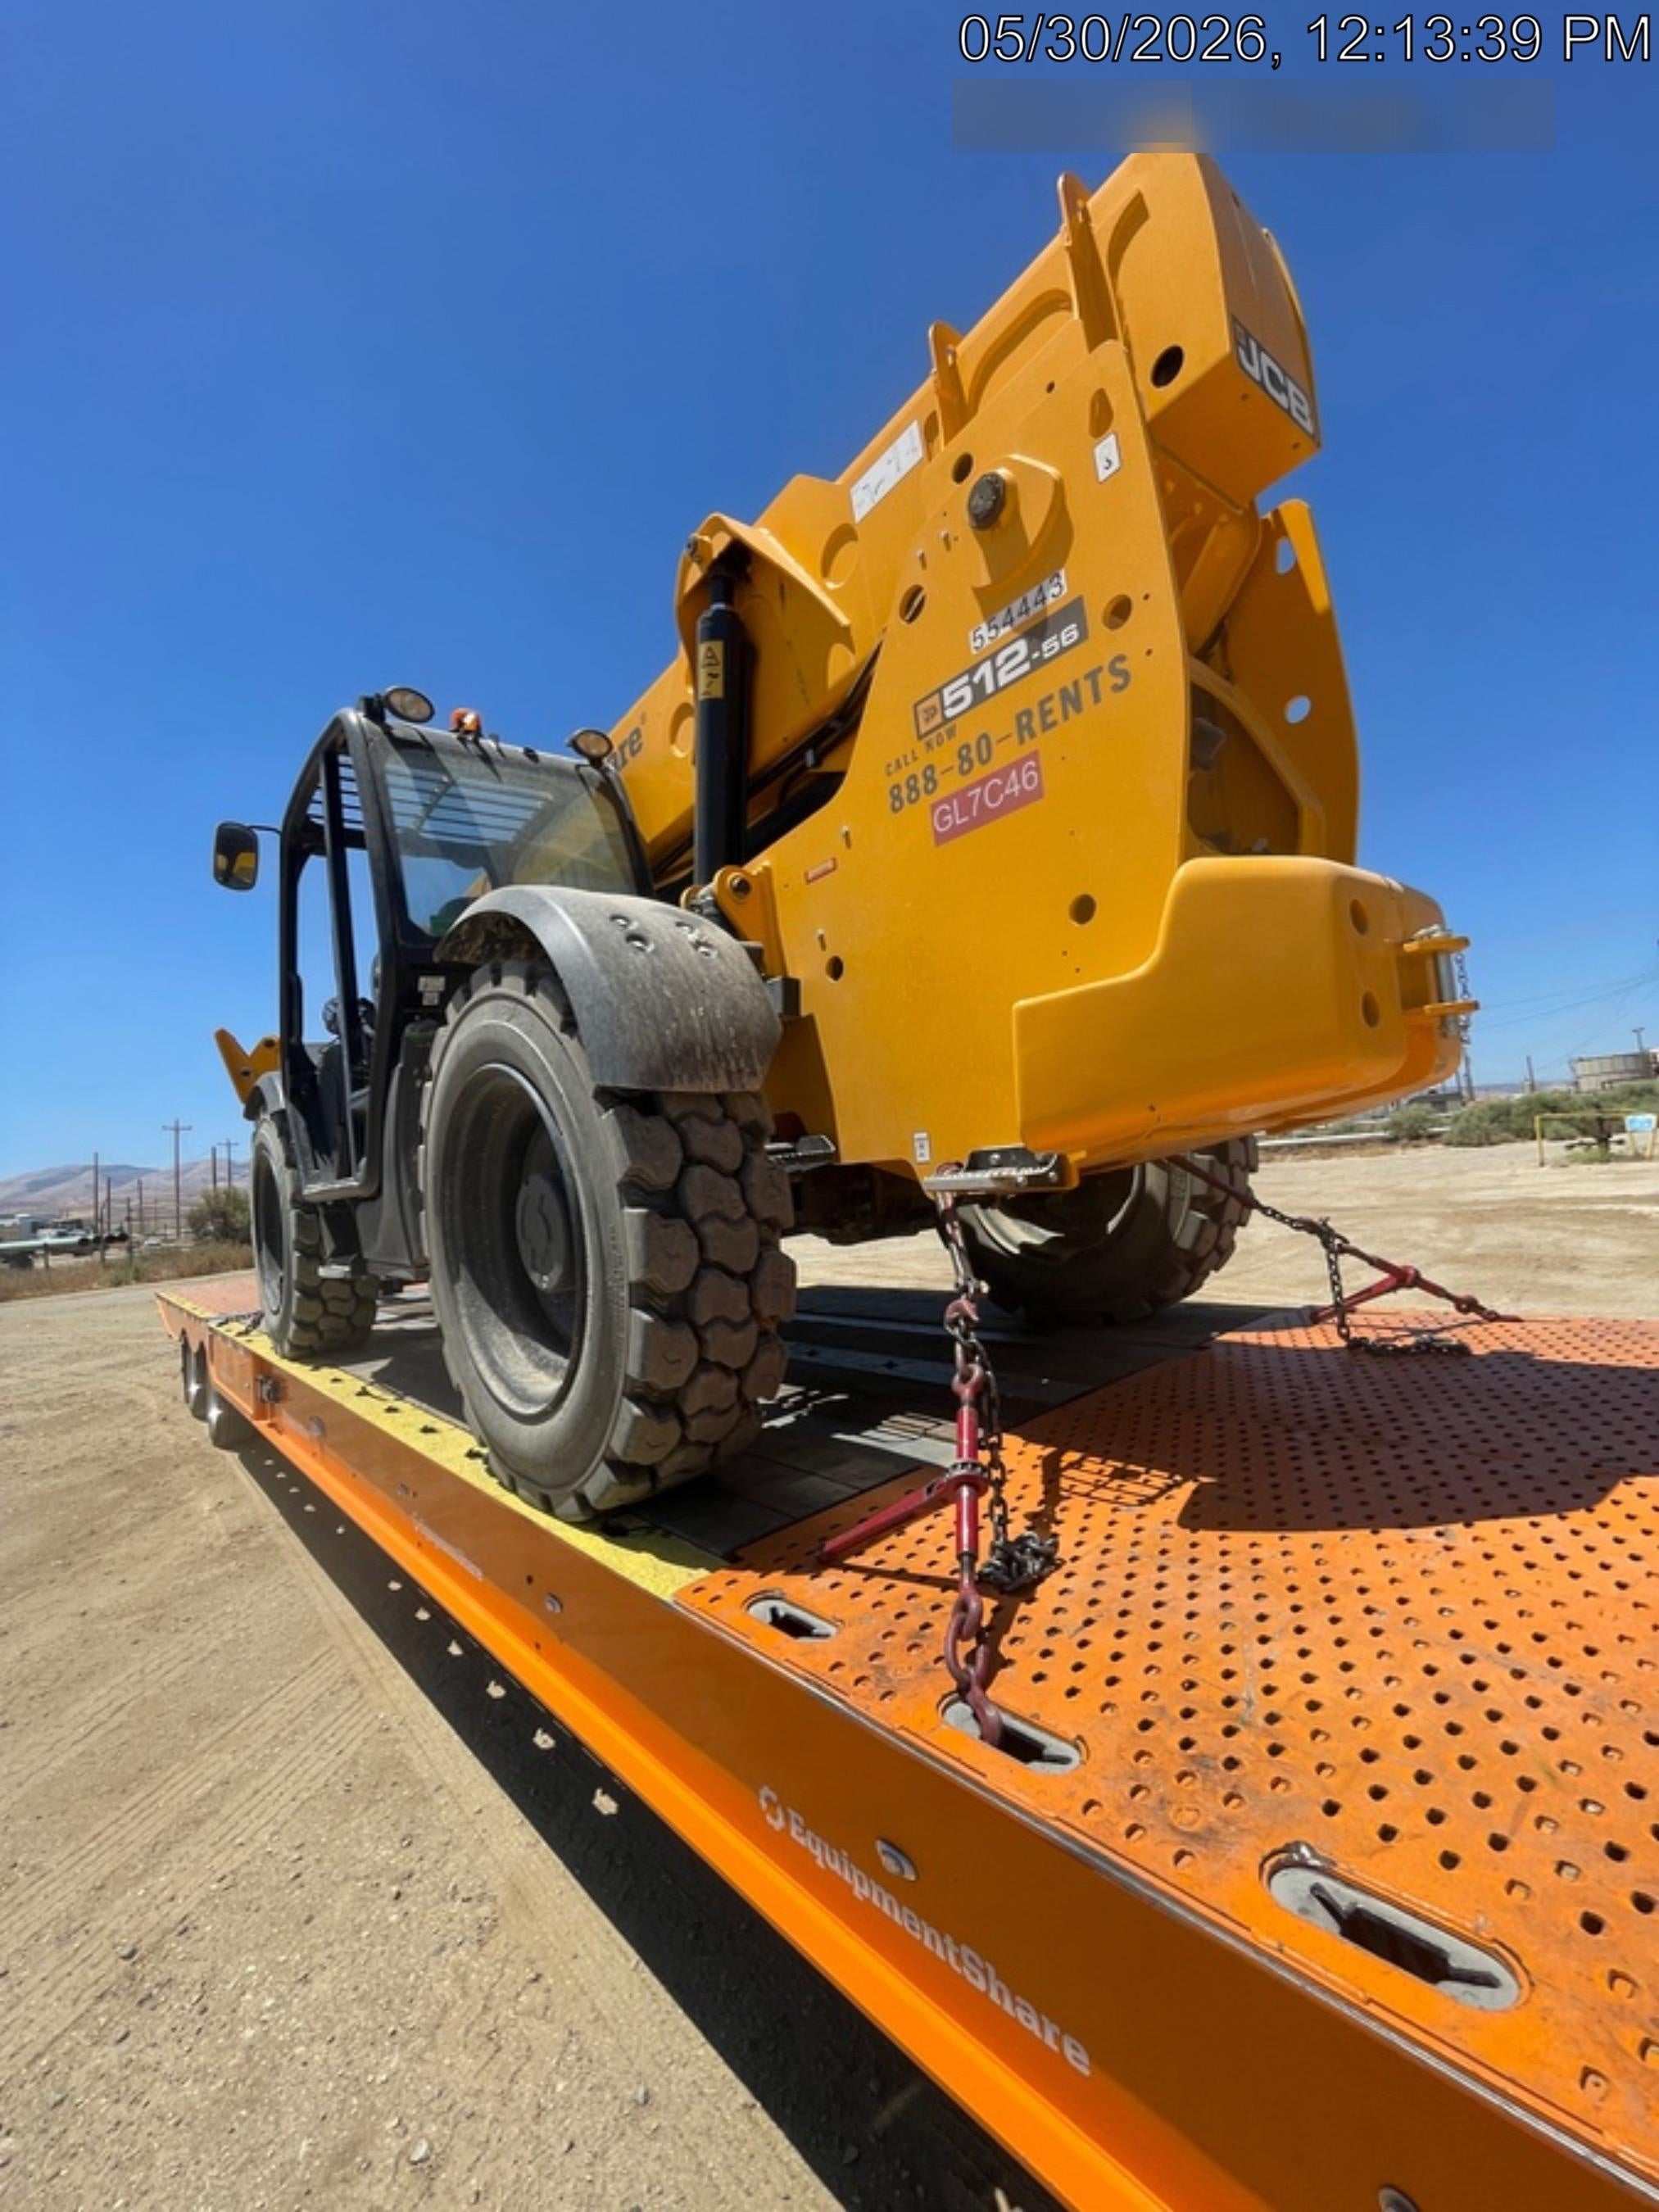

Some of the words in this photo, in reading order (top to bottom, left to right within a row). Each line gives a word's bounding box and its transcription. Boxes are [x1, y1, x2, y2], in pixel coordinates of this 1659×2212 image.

[1237, 336, 1314, 436] JCB
[971, 569, 1065, 651] 554443
[885, 748, 918, 777] CALL
[925, 723, 957, 753] NOW
[889, 653, 1132, 814] 888-80-RENTS
[932, 759, 1040, 832] GL7C46
[786, 1806, 1092, 2078] EquipmentShare
